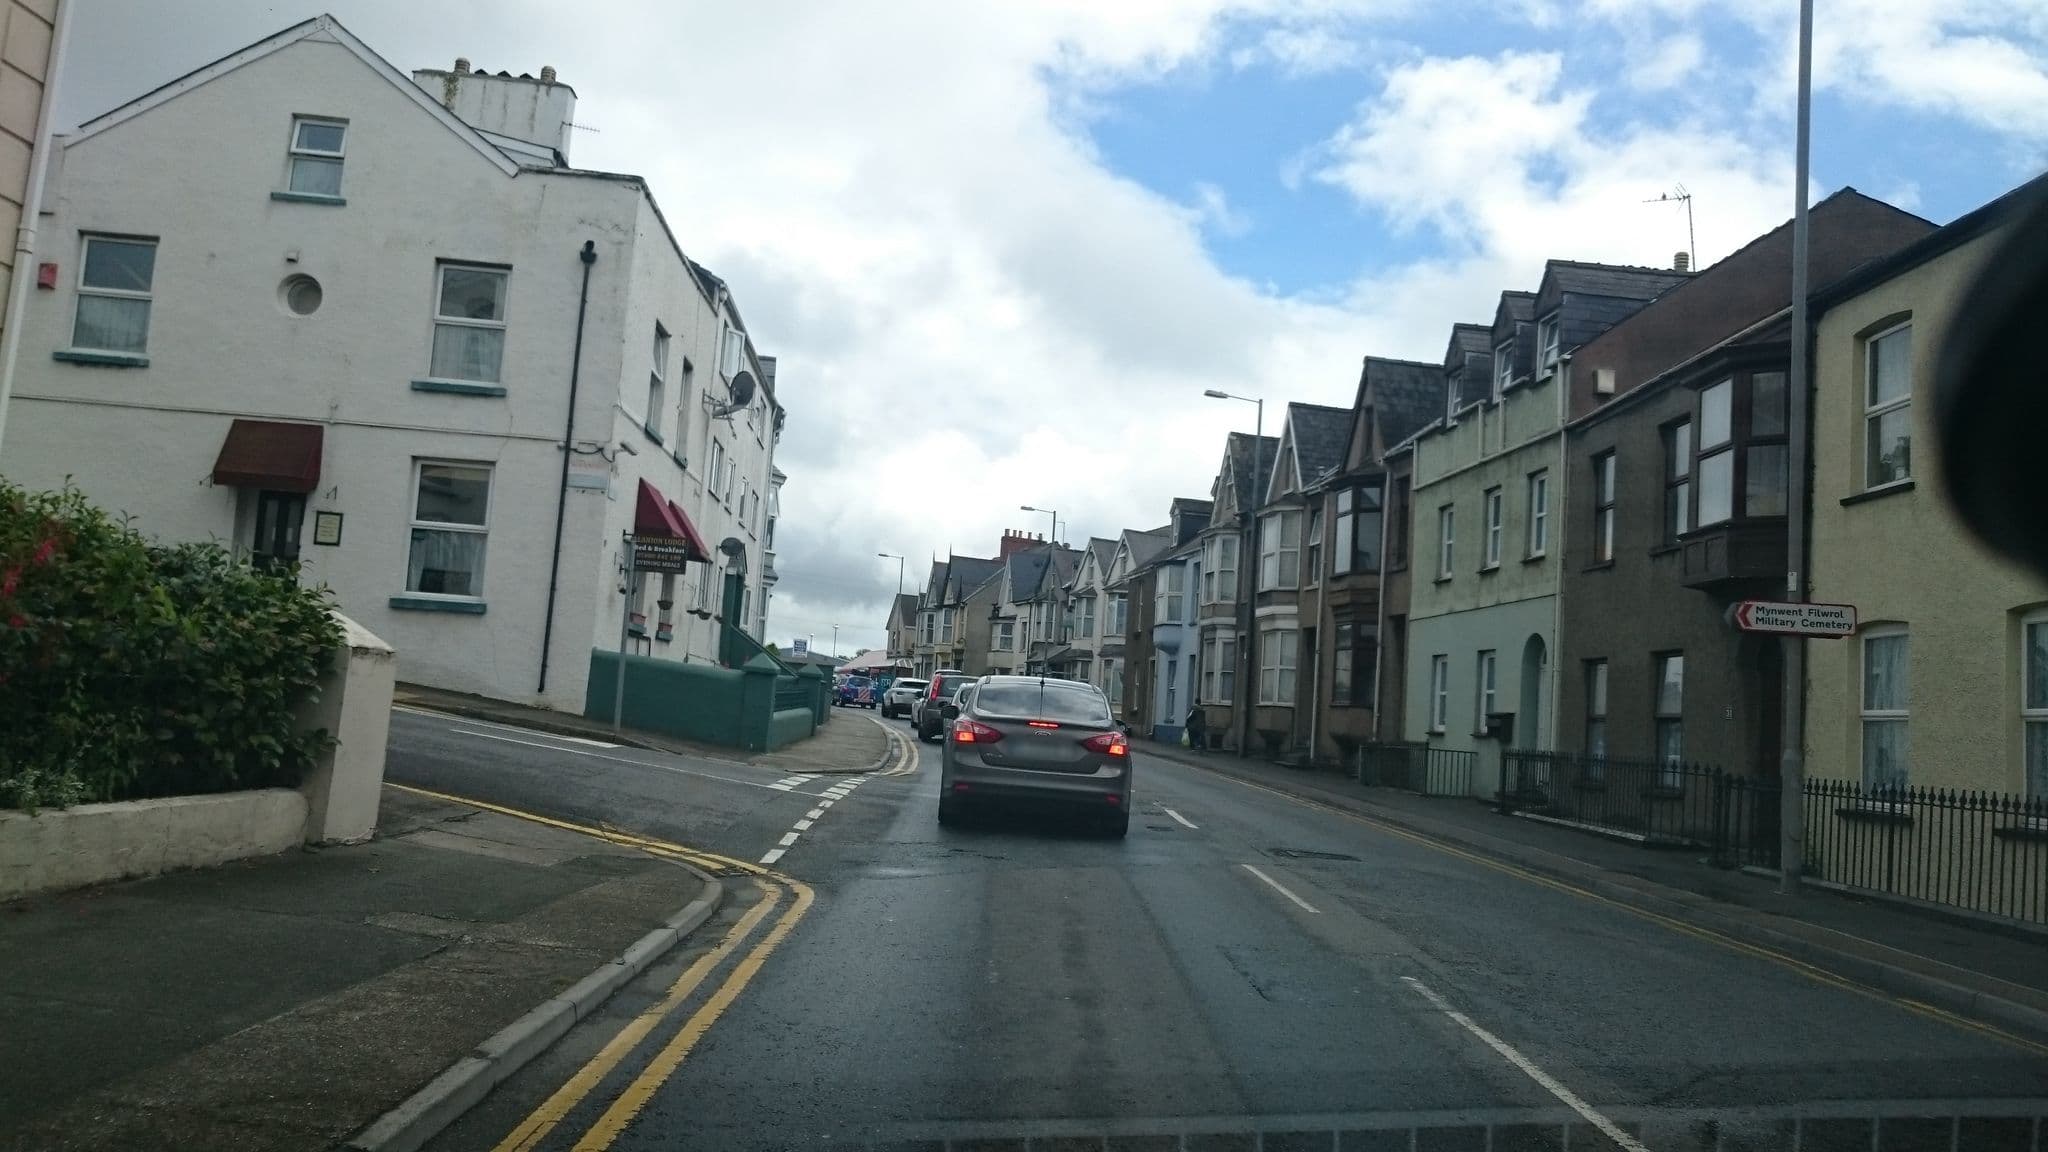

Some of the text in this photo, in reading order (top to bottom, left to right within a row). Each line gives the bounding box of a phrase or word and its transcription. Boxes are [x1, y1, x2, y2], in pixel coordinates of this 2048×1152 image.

[654, 545, 685, 554] Breakfast
[1755, 606, 1844, 619] Mynwent Filwrol
[1755, 617, 1853, 631] Military Cemetery
